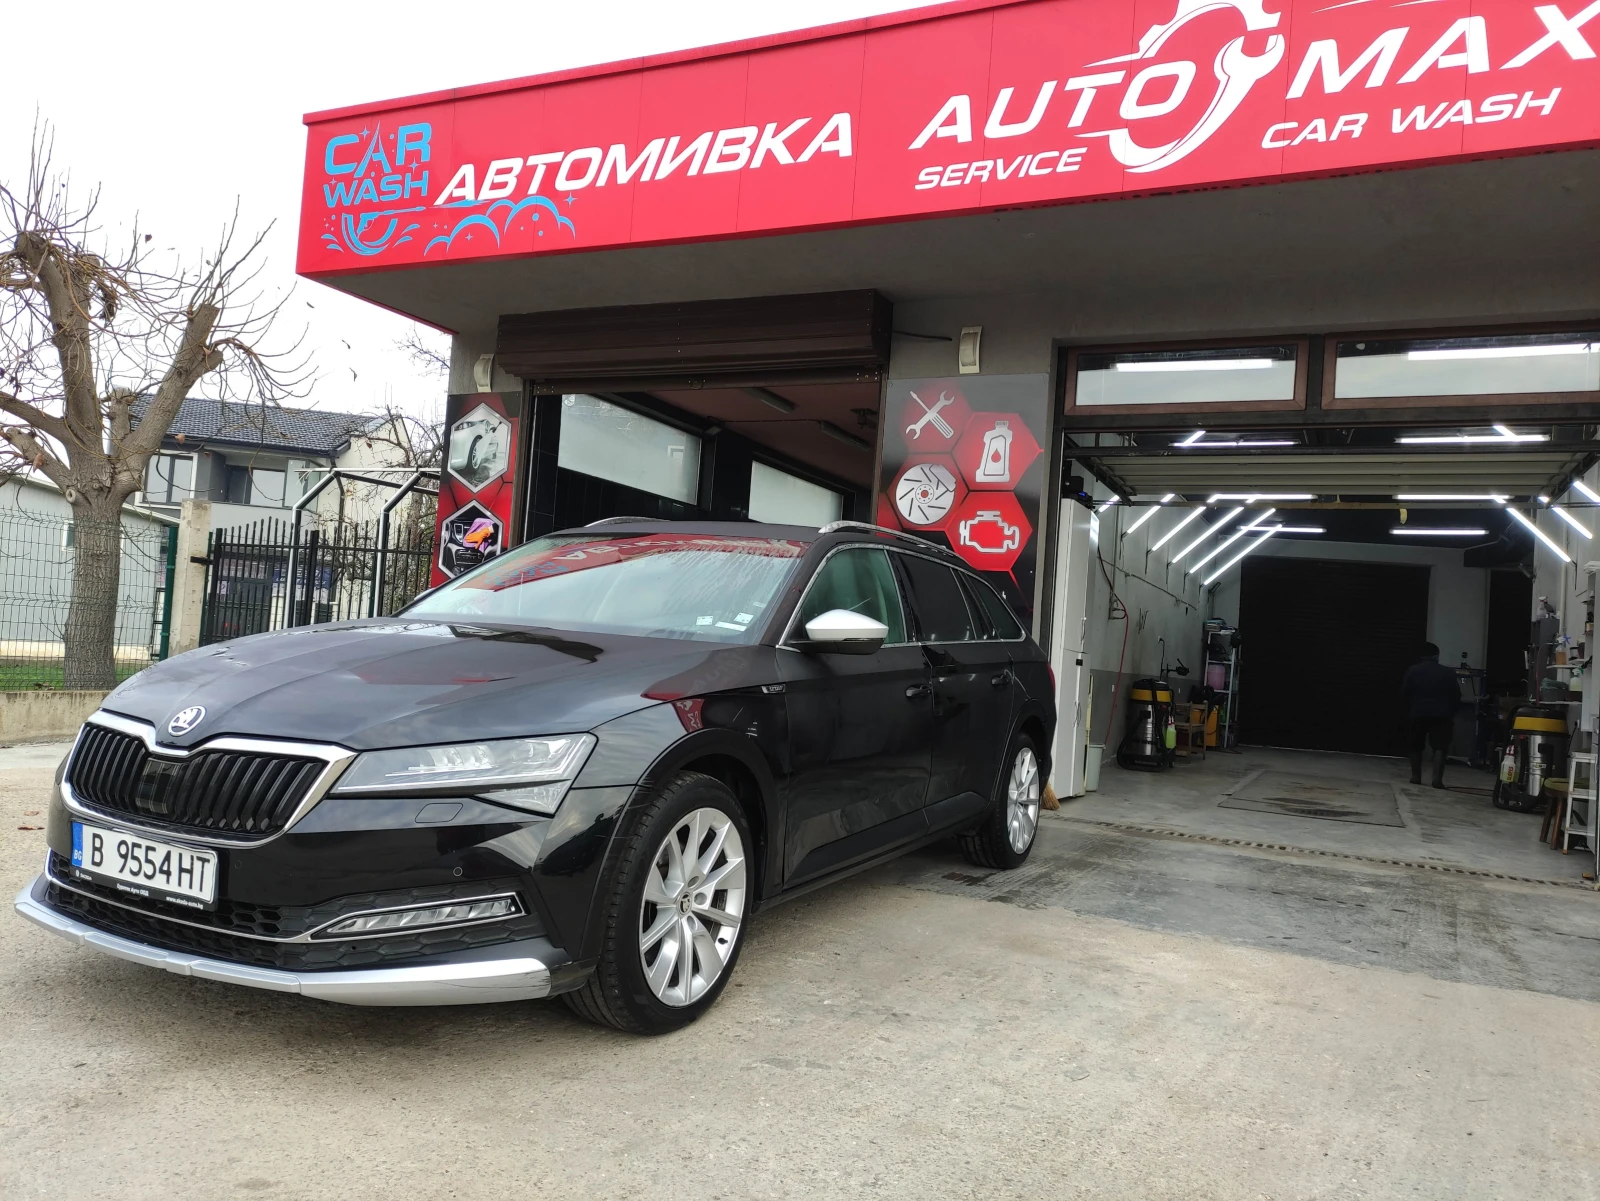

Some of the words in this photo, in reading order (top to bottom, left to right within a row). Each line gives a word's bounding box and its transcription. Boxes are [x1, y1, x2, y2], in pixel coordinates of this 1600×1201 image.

[907, 60, 1197, 150] AUTO
[1285, 0, 1600, 100] MAX
[1261, 112, 1369, 149] CAR
[1391, 87, 1562, 134] WASH
[324, 121, 432, 178] CAR
[433, 112, 853, 208] АВТОМИВКА
[914, 147, 1088, 190] SERVICE
[323, 170, 429, 208] WASH
[73, 849, 83, 861] BG
[91, 832, 104, 867] B
[117, 839, 172, 885] 9554
[177, 852, 211, 892] HT
